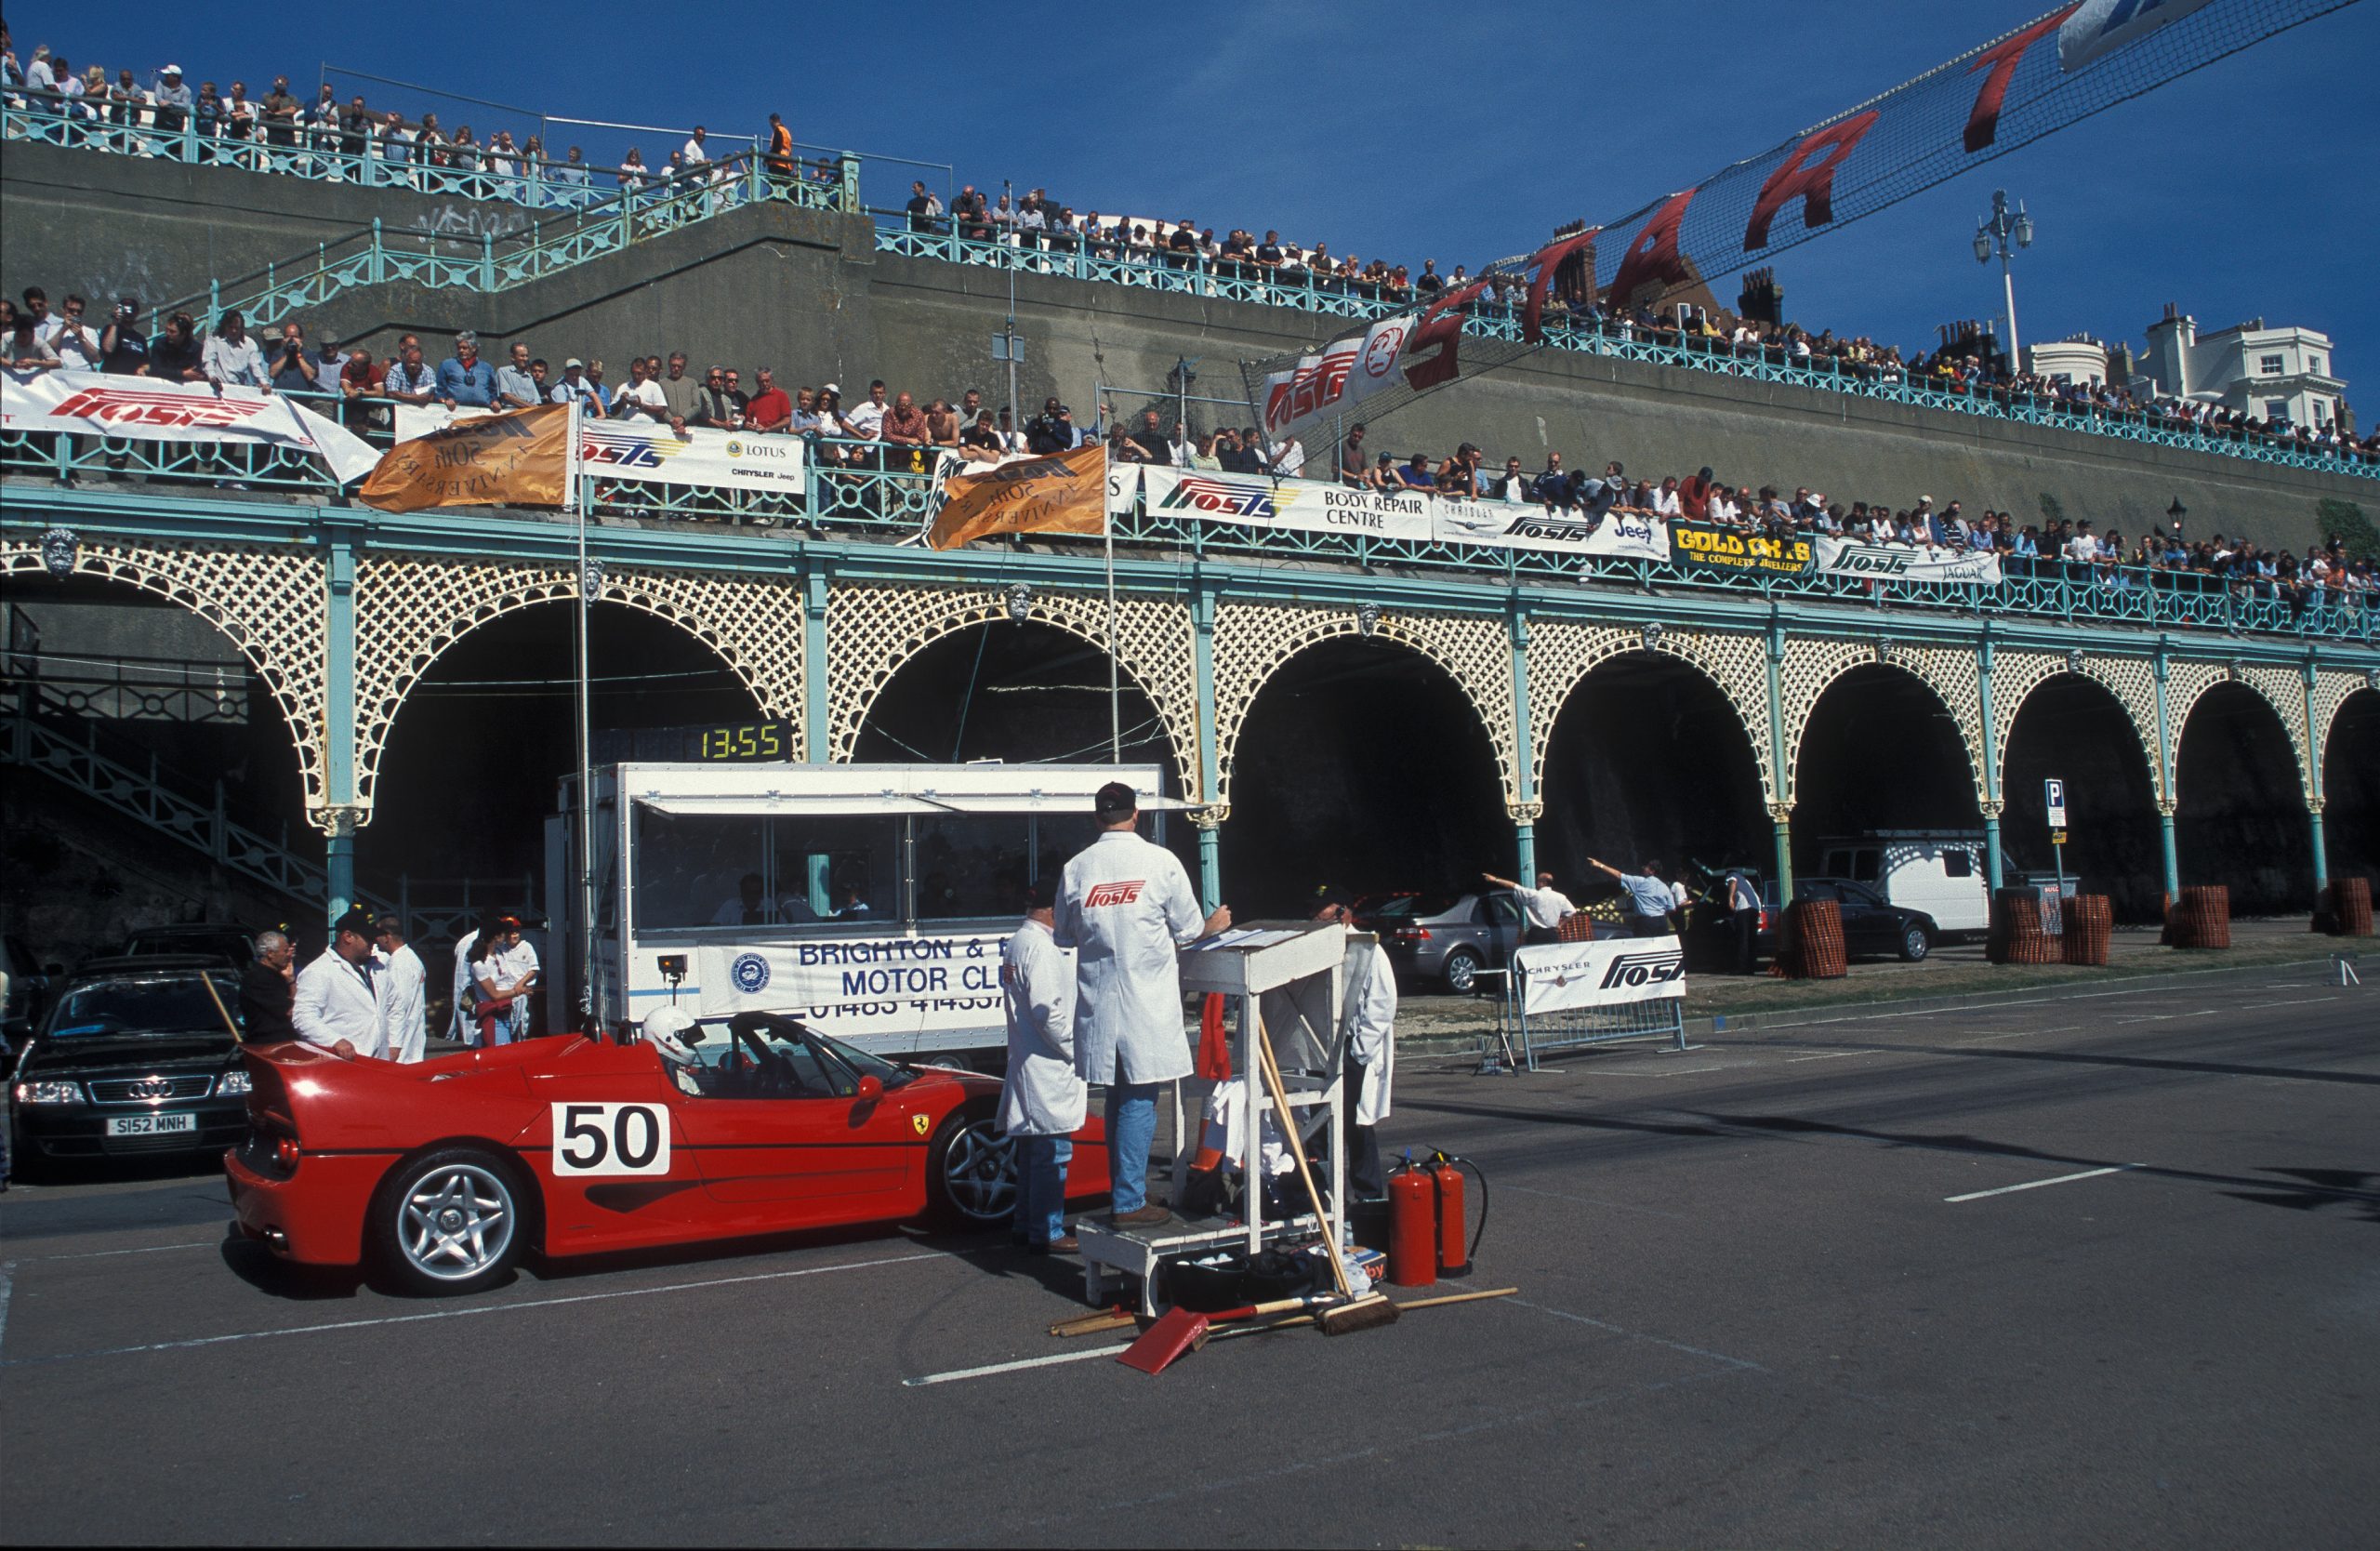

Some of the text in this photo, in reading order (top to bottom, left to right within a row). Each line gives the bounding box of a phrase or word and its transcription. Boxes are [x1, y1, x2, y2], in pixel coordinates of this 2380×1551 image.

[1404, 2, 2069, 391] START
[747, 444, 787, 458] LOTUS
[732, 468, 795, 481] CHRYSLER Jeep
[1157, 478, 1302, 518] Frosts
[1324, 491, 1423, 514] BODY REPAIR
[1326, 509, 1384, 529] CENTRE
[1502, 516, 1592, 541] Frosts
[1614, 523, 1652, 544] Jeep
[1675, 528, 1744, 555] GOLD
[1689, 551, 1706, 562] THE
[1708, 554, 1756, 567] COMPLETE
[1831, 544, 1919, 575] Frosts
[1942, 565, 1983, 581] JAGUAR
[2049, 783, 2060, 806] P
[1084, 880, 1145, 908] Frosts
[800, 939, 953, 966] BRIGHTON
[966, 938, 985, 959] &
[1527, 961, 1591, 975] CHRYSLER
[842, 967, 948, 996] MOTOR
[117, 1116, 186, 1133] S152 MNH
[562, 1106, 660, 1169] 50
